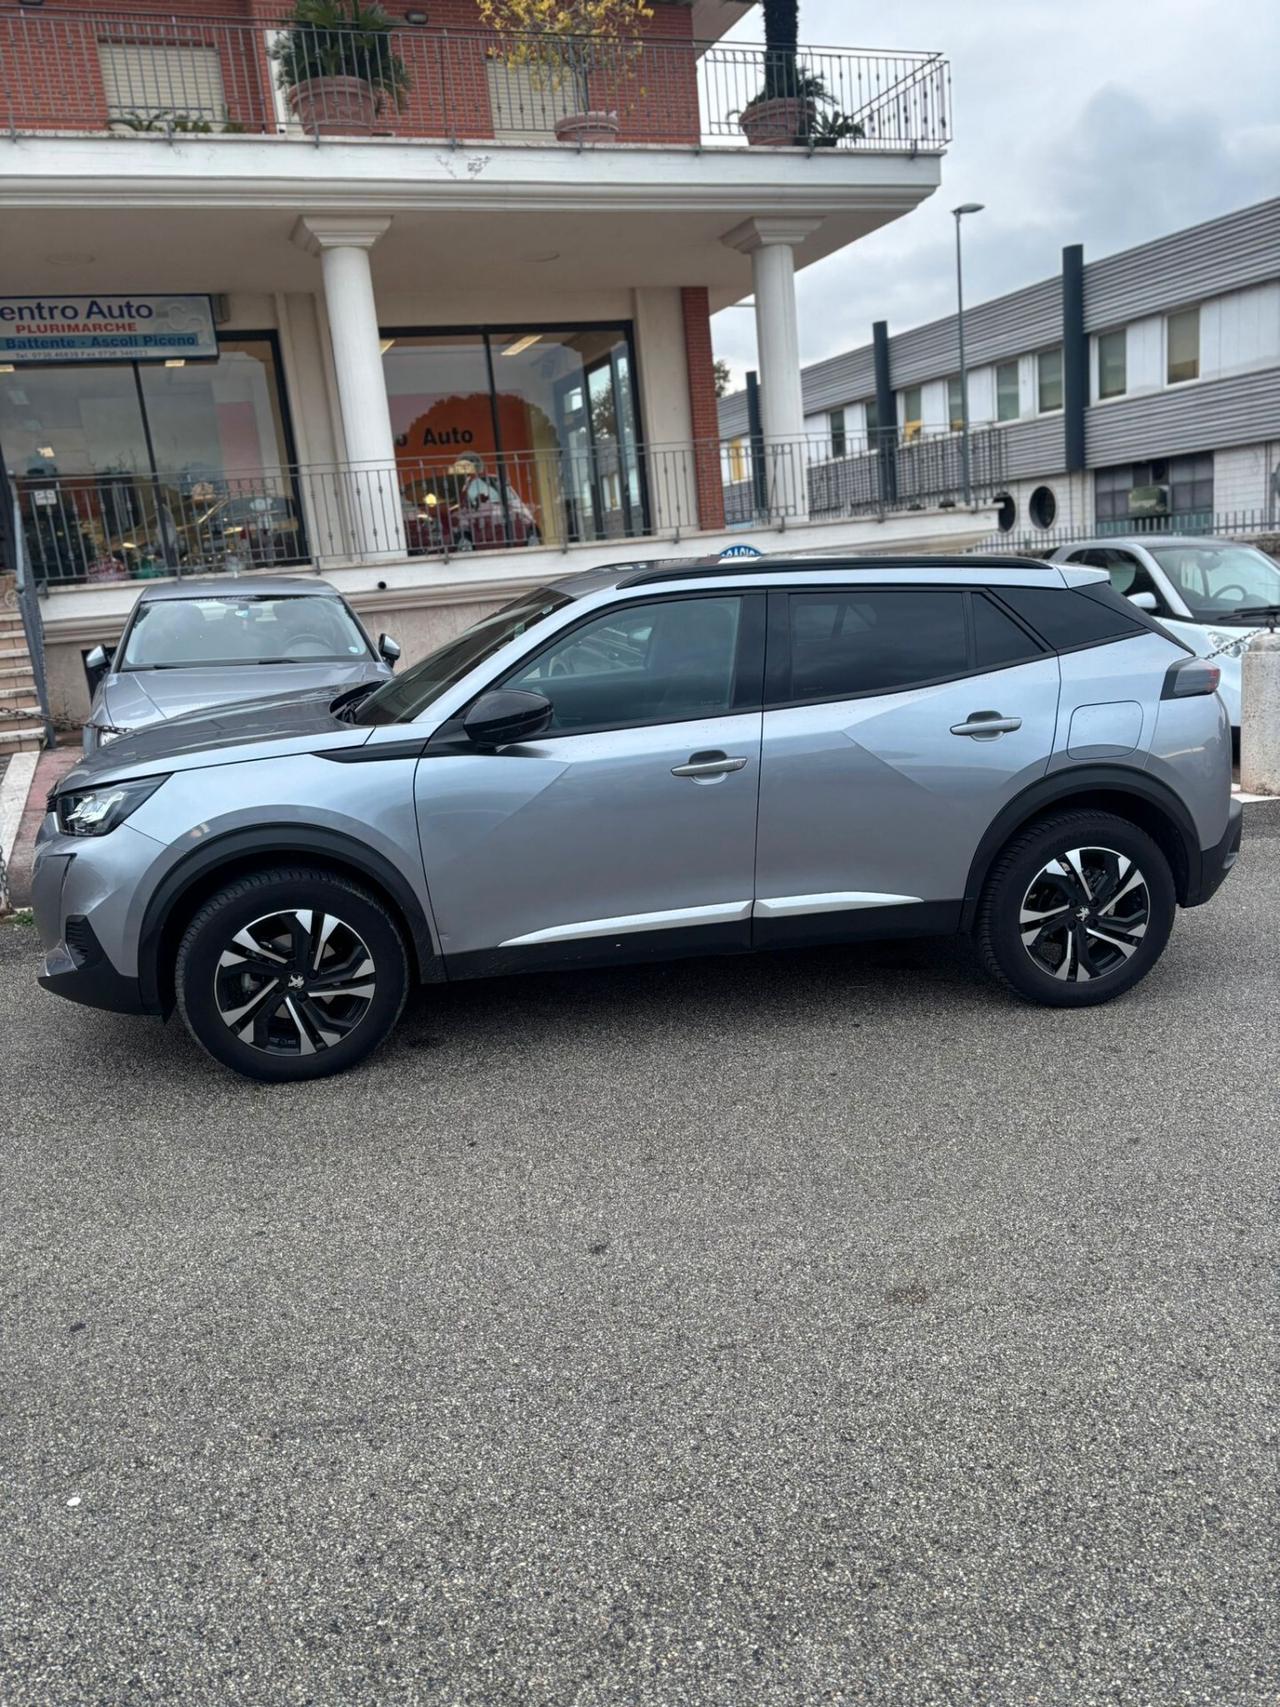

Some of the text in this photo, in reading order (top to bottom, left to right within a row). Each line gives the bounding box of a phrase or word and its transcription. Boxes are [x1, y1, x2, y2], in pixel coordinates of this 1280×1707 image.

[86, 300, 153, 319] Auto
[15, 322, 137, 334] PLURIMARCHE
[6, 338, 76, 350] Battente
[91, 336, 138, 349] Ascoli
[143, 335, 196, 347] Piceno
[423, 427, 474, 446] Auto
